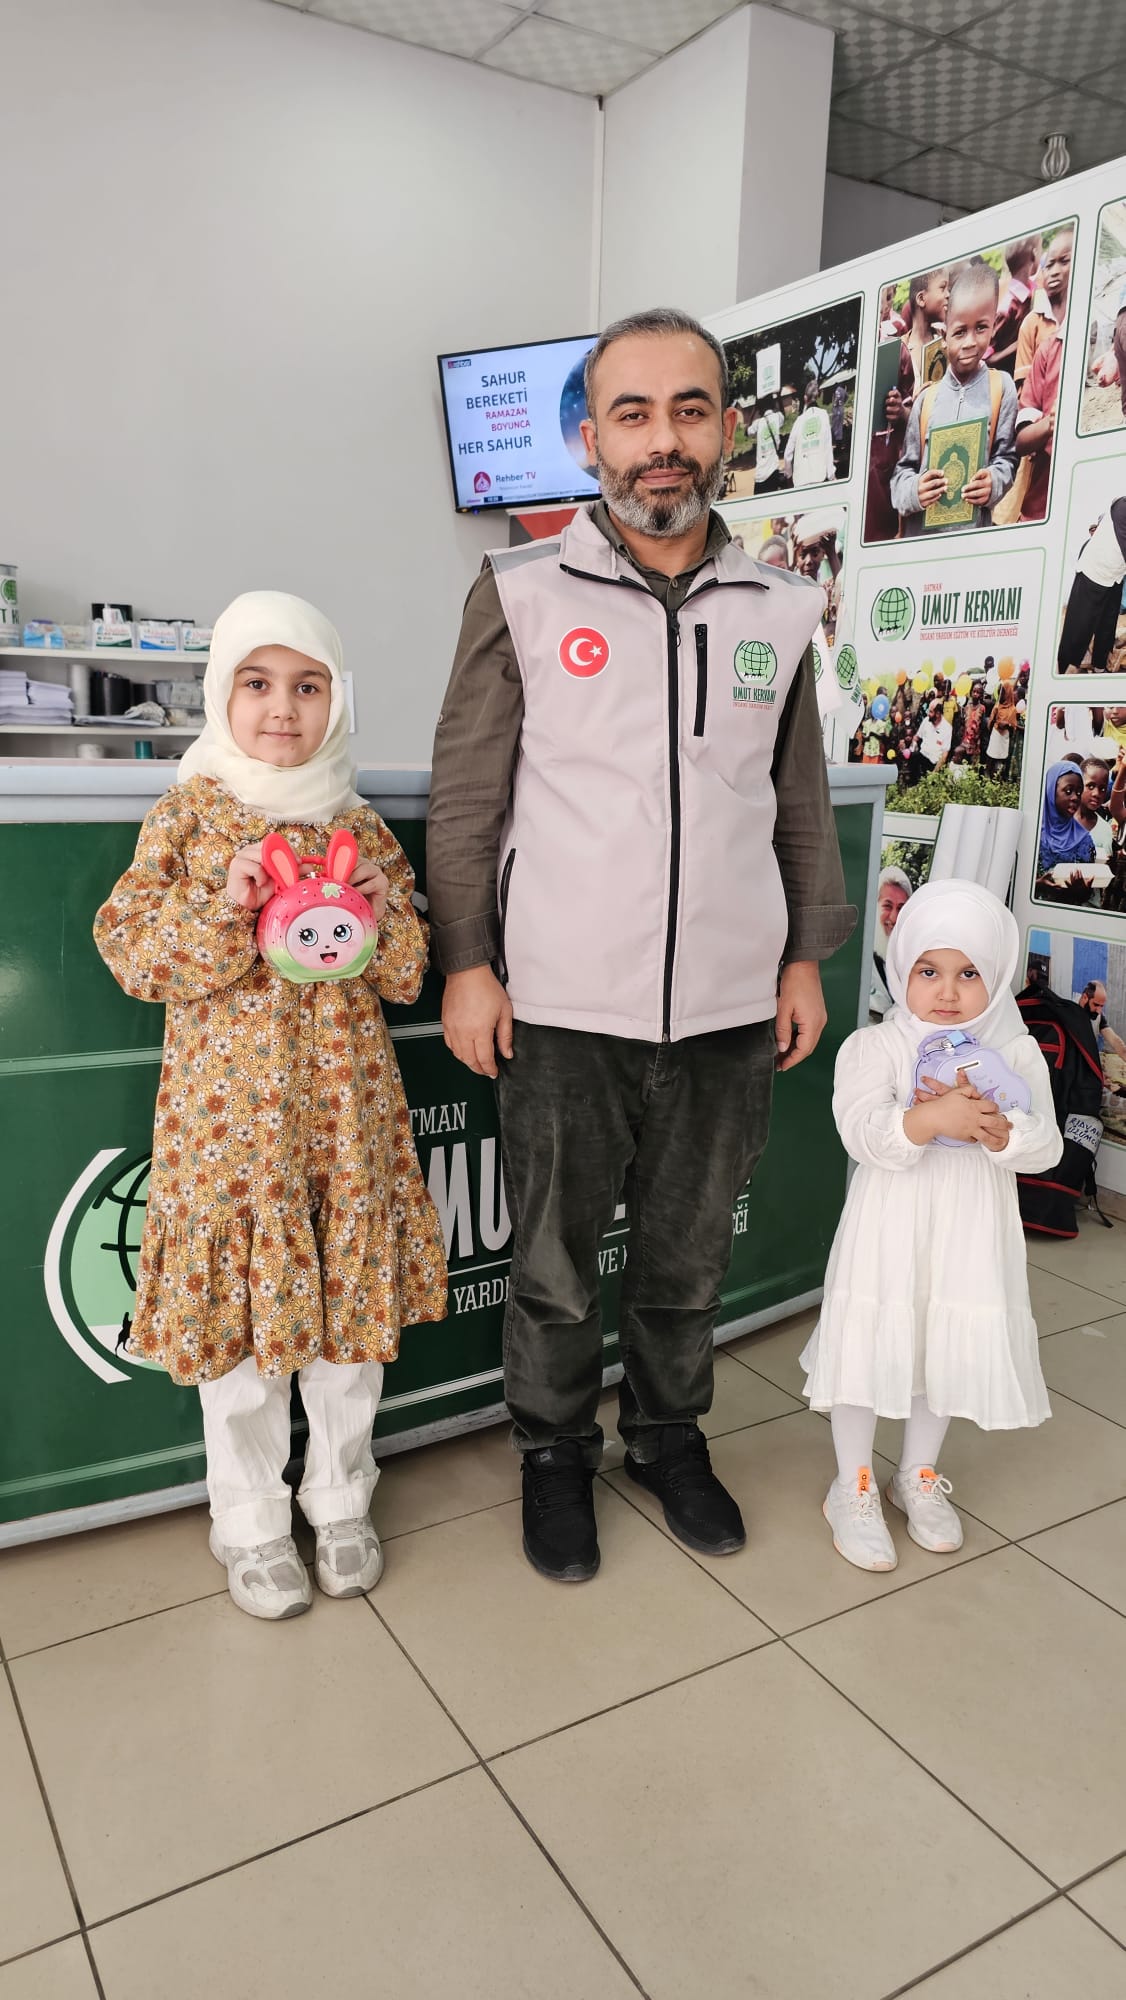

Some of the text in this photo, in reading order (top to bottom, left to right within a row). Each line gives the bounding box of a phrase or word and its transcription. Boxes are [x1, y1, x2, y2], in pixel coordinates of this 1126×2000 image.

[481, 370, 526, 387] SAHUR
[466, 388, 528, 409] BEREKETİ
[485, 408, 528, 419] RAMAZAN
[491, 420, 531, 432] BOYUNCA
[458, 436, 532, 455] HER SAHUR
[495, 472, 536, 483] Rehber TV
[922, 587, 1022, 625] UMUT KERVANI
[733, 686, 751, 700] UMUT
[409, 1102, 467, 1136] TMAN
[427, 1137, 512, 1260] MU
[453, 1276, 510, 1314] YARDI
[598, 1247, 619, 1276] VE
